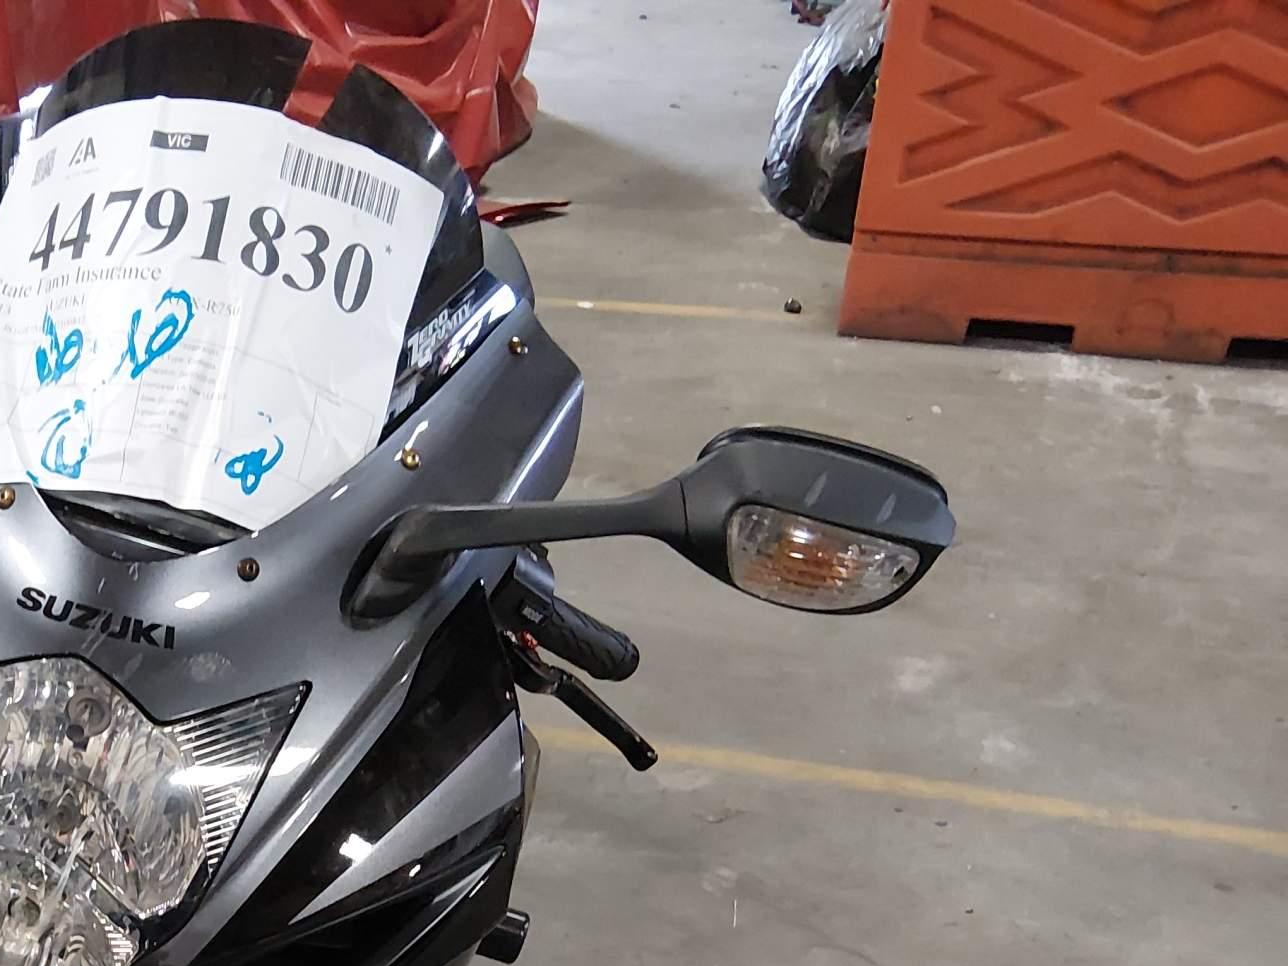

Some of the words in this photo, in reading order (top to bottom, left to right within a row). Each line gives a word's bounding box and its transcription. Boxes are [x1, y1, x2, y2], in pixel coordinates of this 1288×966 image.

[167, 134, 192, 148] VIC
[28, 186, 374, 314] 44791830
[75, 263, 163, 286] Insurance
[16, 586, 176, 650] SUZUKI
